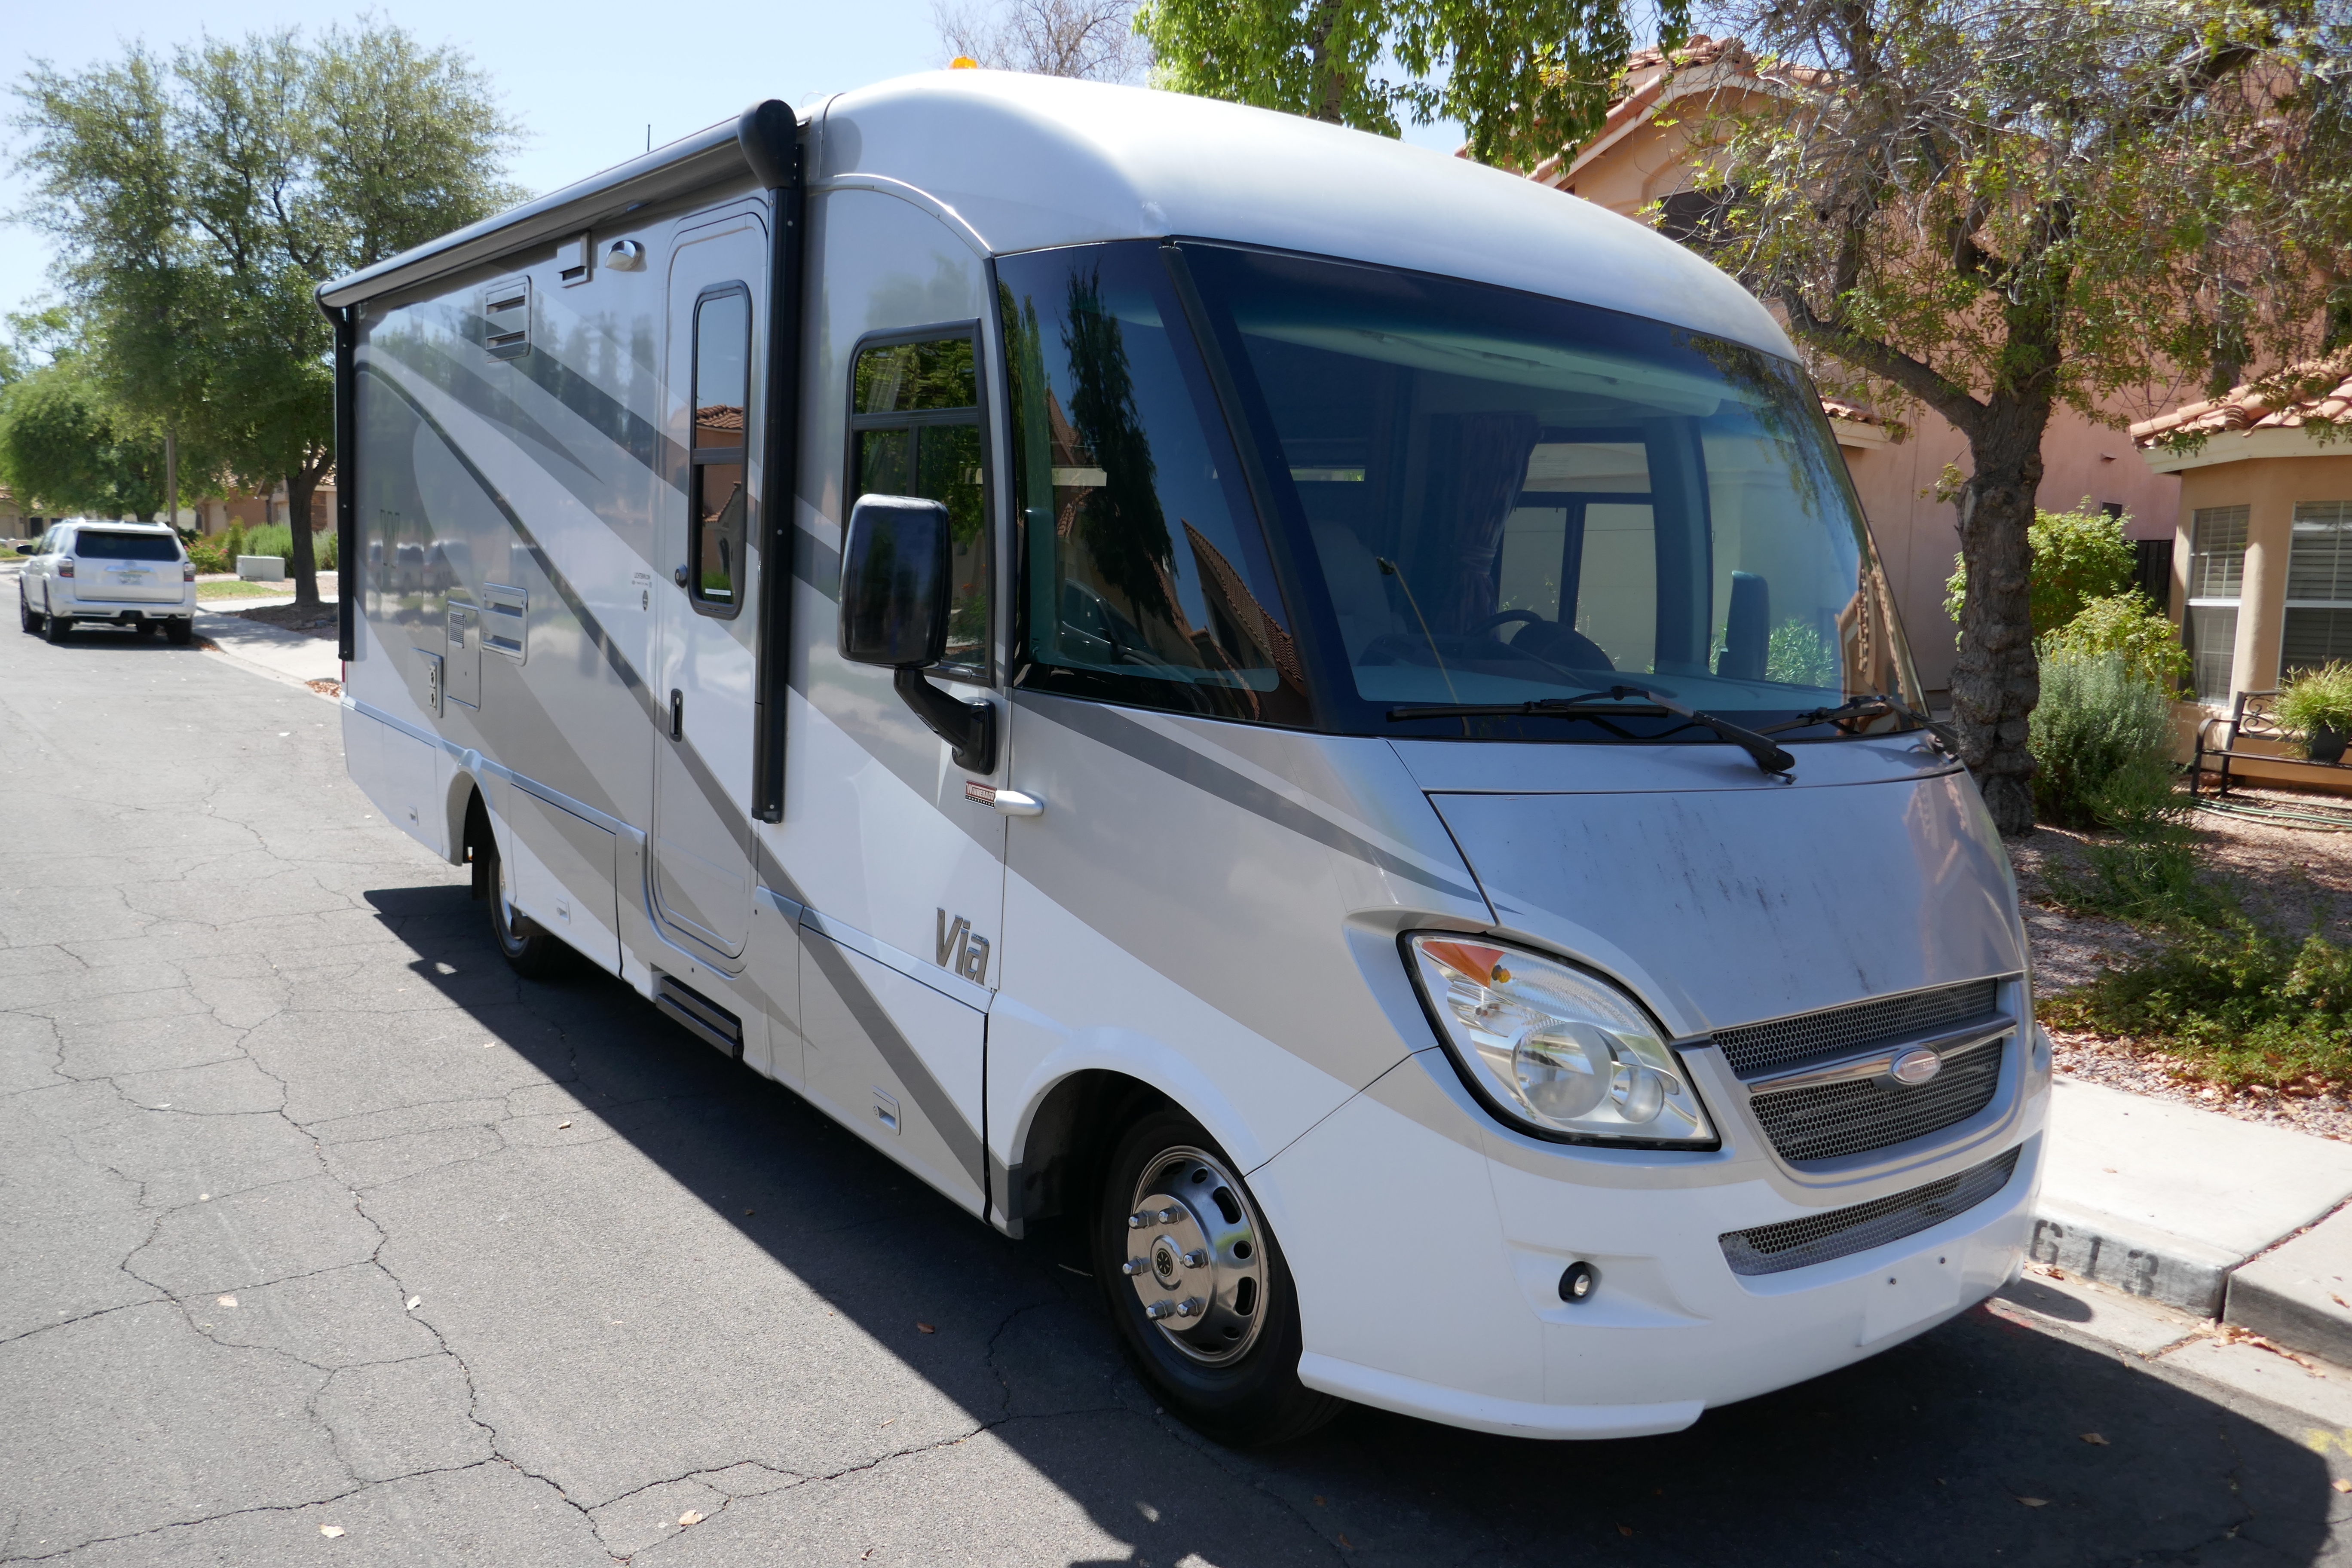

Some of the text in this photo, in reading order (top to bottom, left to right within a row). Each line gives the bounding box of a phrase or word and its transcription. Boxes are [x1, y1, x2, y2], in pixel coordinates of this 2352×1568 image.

[966, 783, 995, 800] WINNEBAGO
[966, 796, 993, 806] INDUSTRIES
[936, 907, 990, 986] Via
